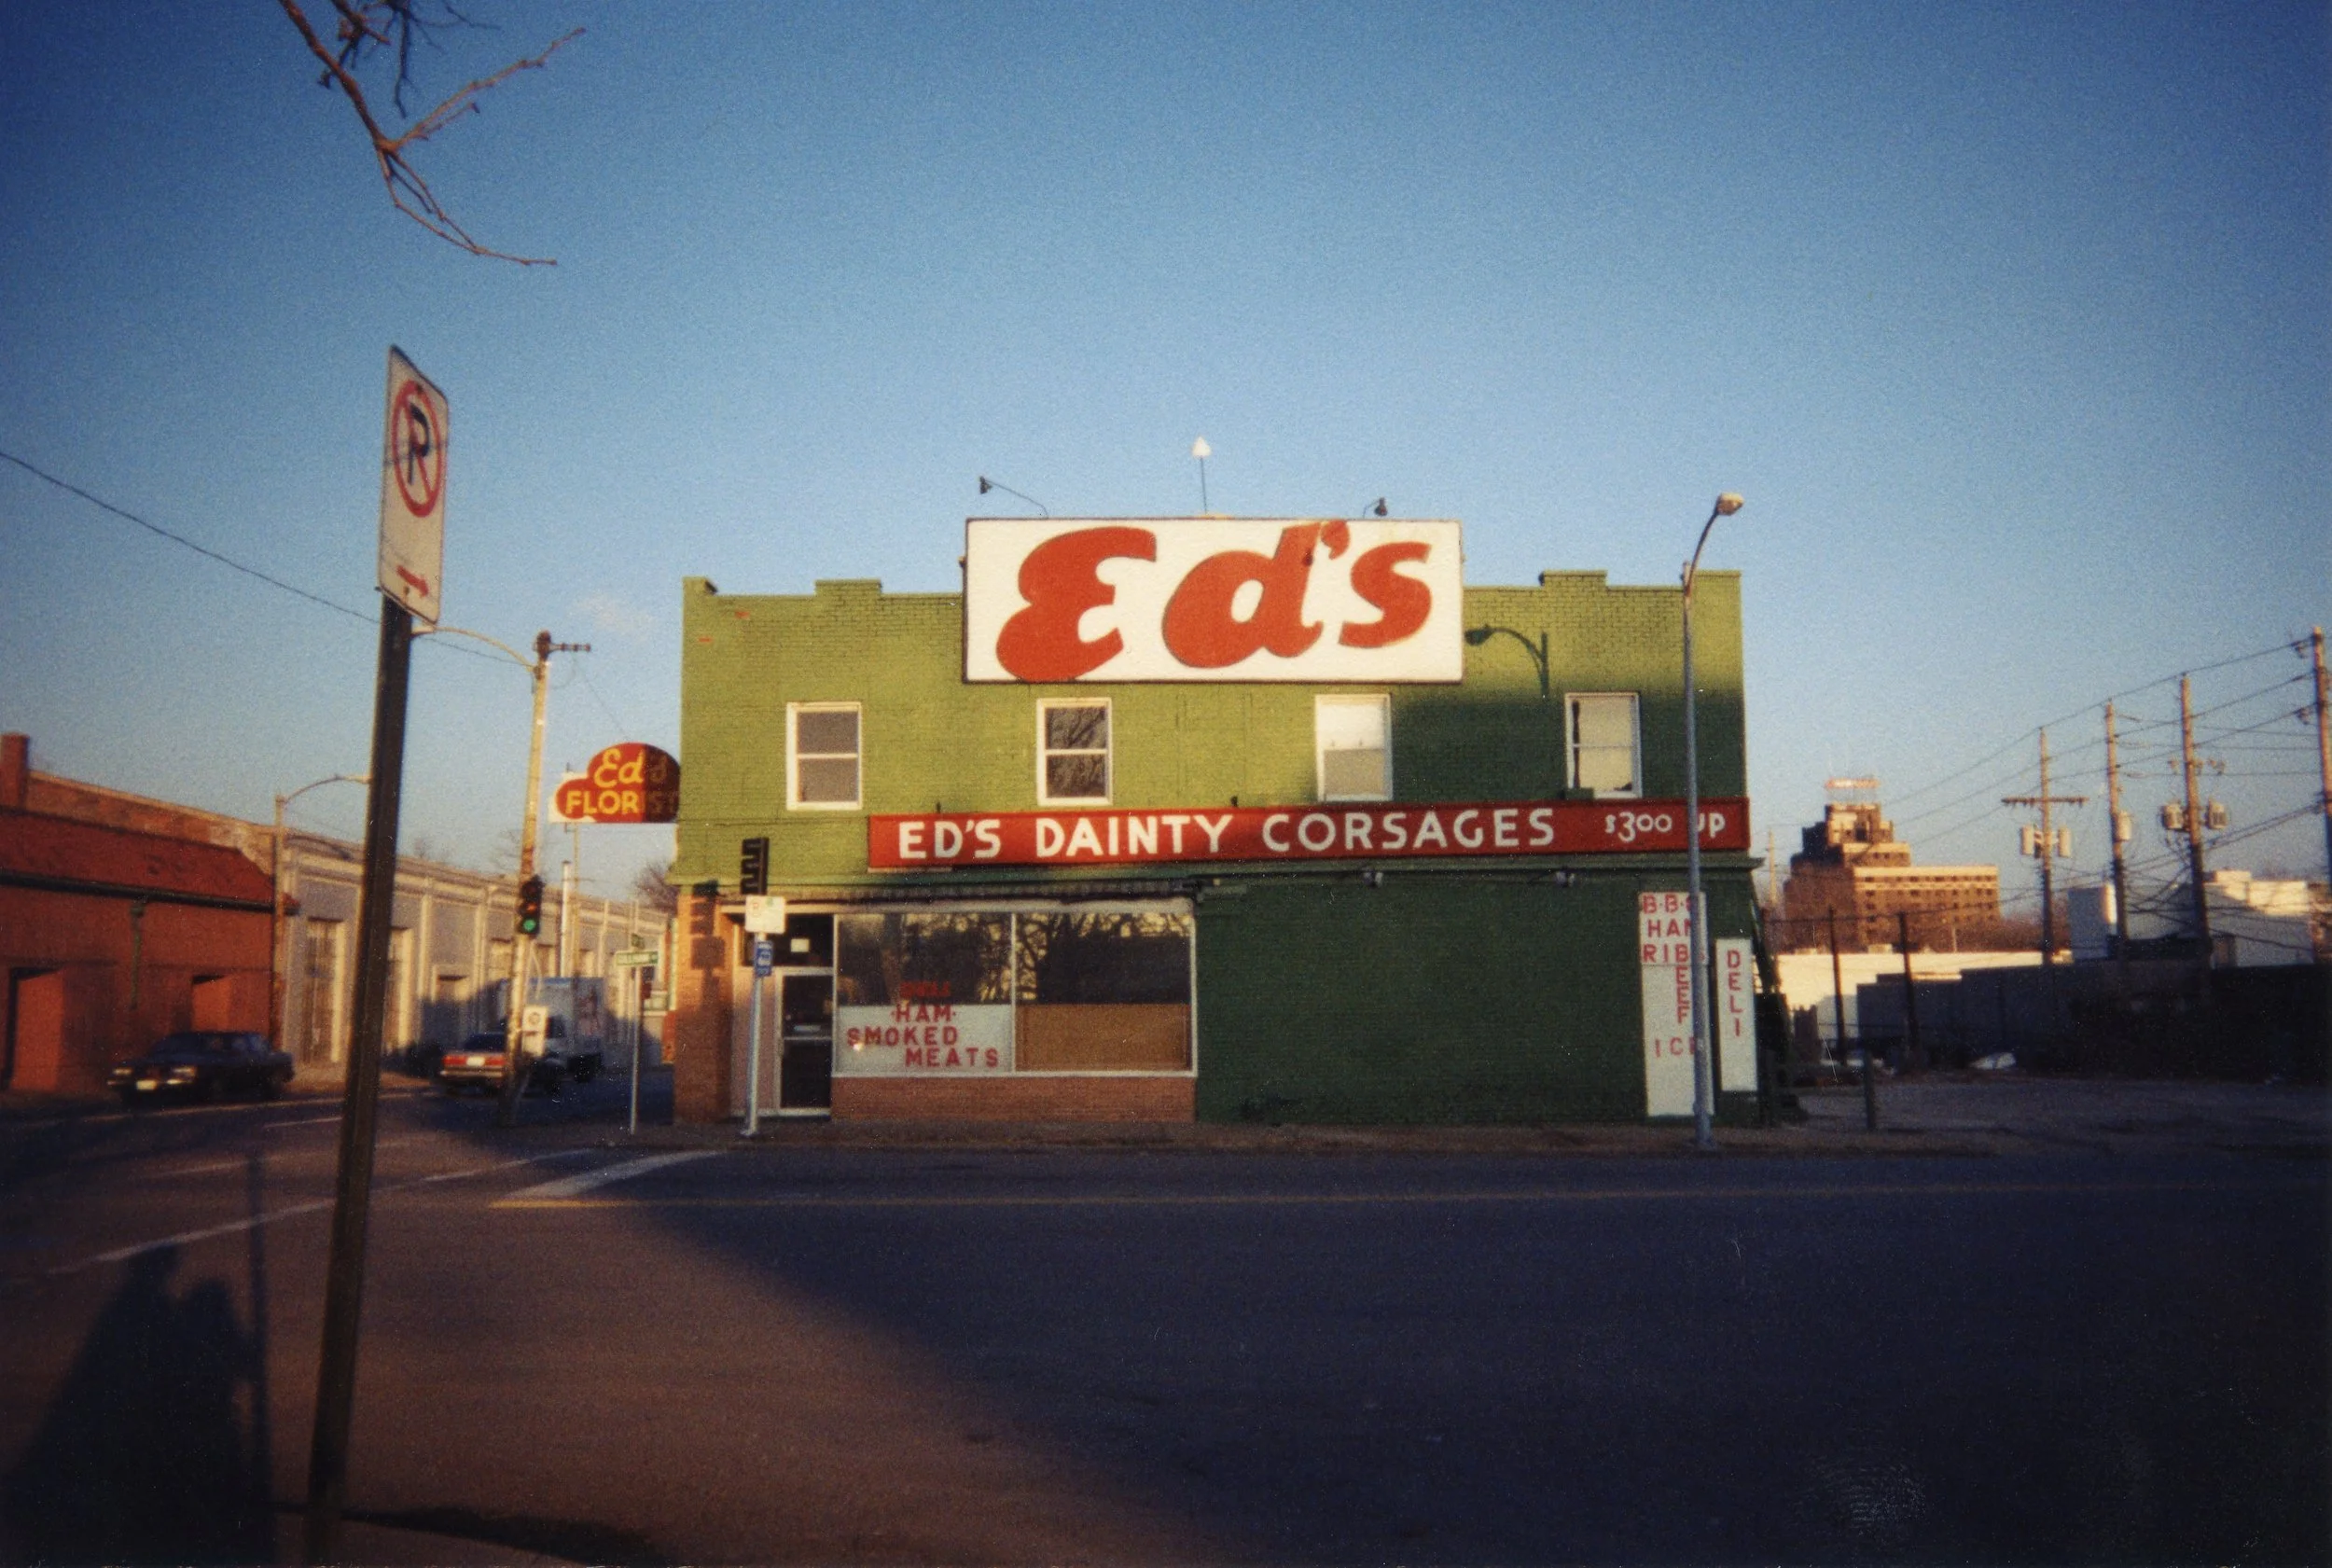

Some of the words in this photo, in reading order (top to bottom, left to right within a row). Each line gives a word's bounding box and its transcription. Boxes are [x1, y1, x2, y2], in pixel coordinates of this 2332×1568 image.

[995, 520, 1433, 683] Ed's
[898, 817, 1002, 860] ED'S
[1035, 813, 1234, 858] DAINTY
[1262, 808, 1555, 853] CORSAGES
[1726, 949, 1742, 1038] DELI
[846, 1025, 959, 1047] SMOKED
[905, 1047, 1000, 1069] MEATS
